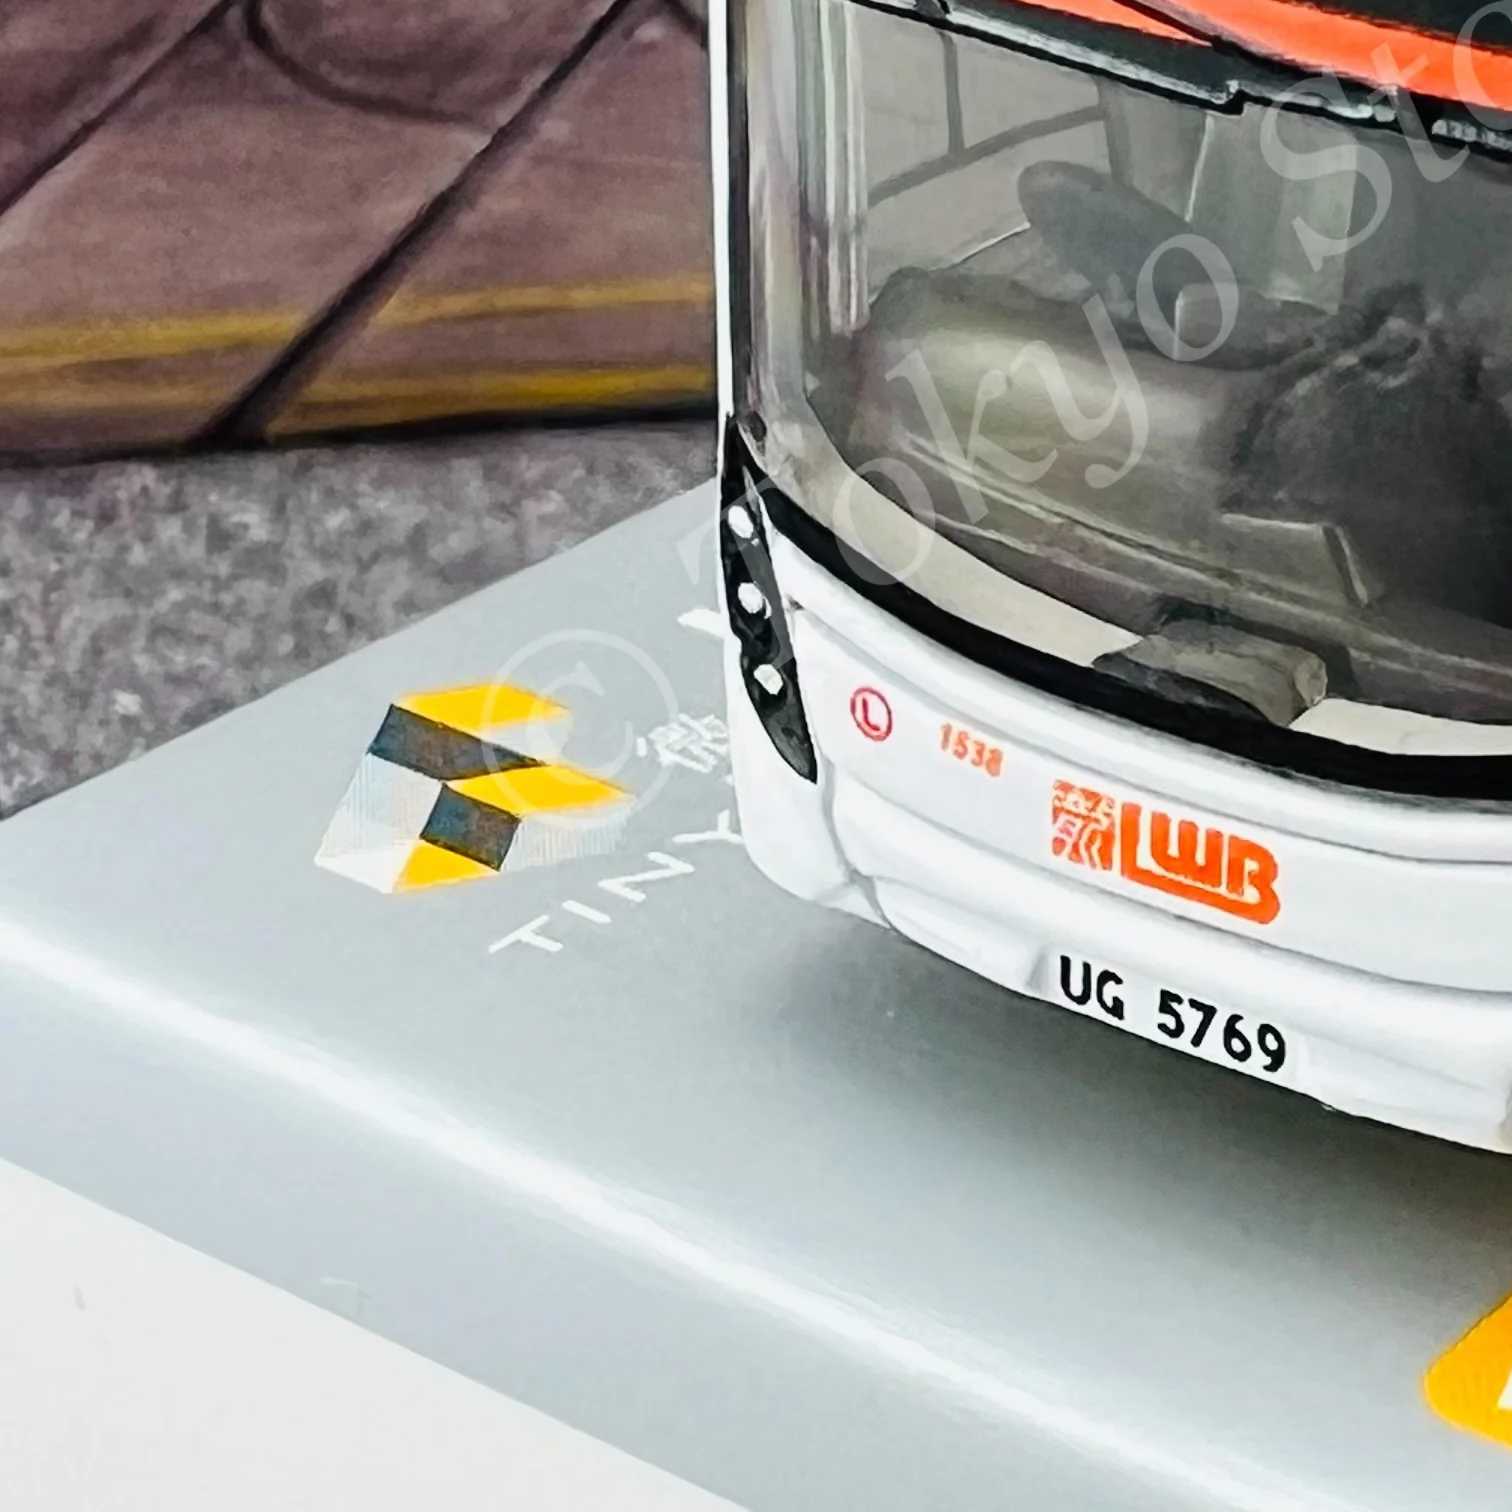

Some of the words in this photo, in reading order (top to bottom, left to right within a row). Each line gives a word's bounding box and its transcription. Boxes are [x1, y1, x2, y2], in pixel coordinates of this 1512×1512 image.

[488, 809, 746, 955] TINY
[1120, 801, 1282, 926] LWB
[1058, 954, 1126, 1022] UG
[1156, 987, 1288, 1074] 5769
